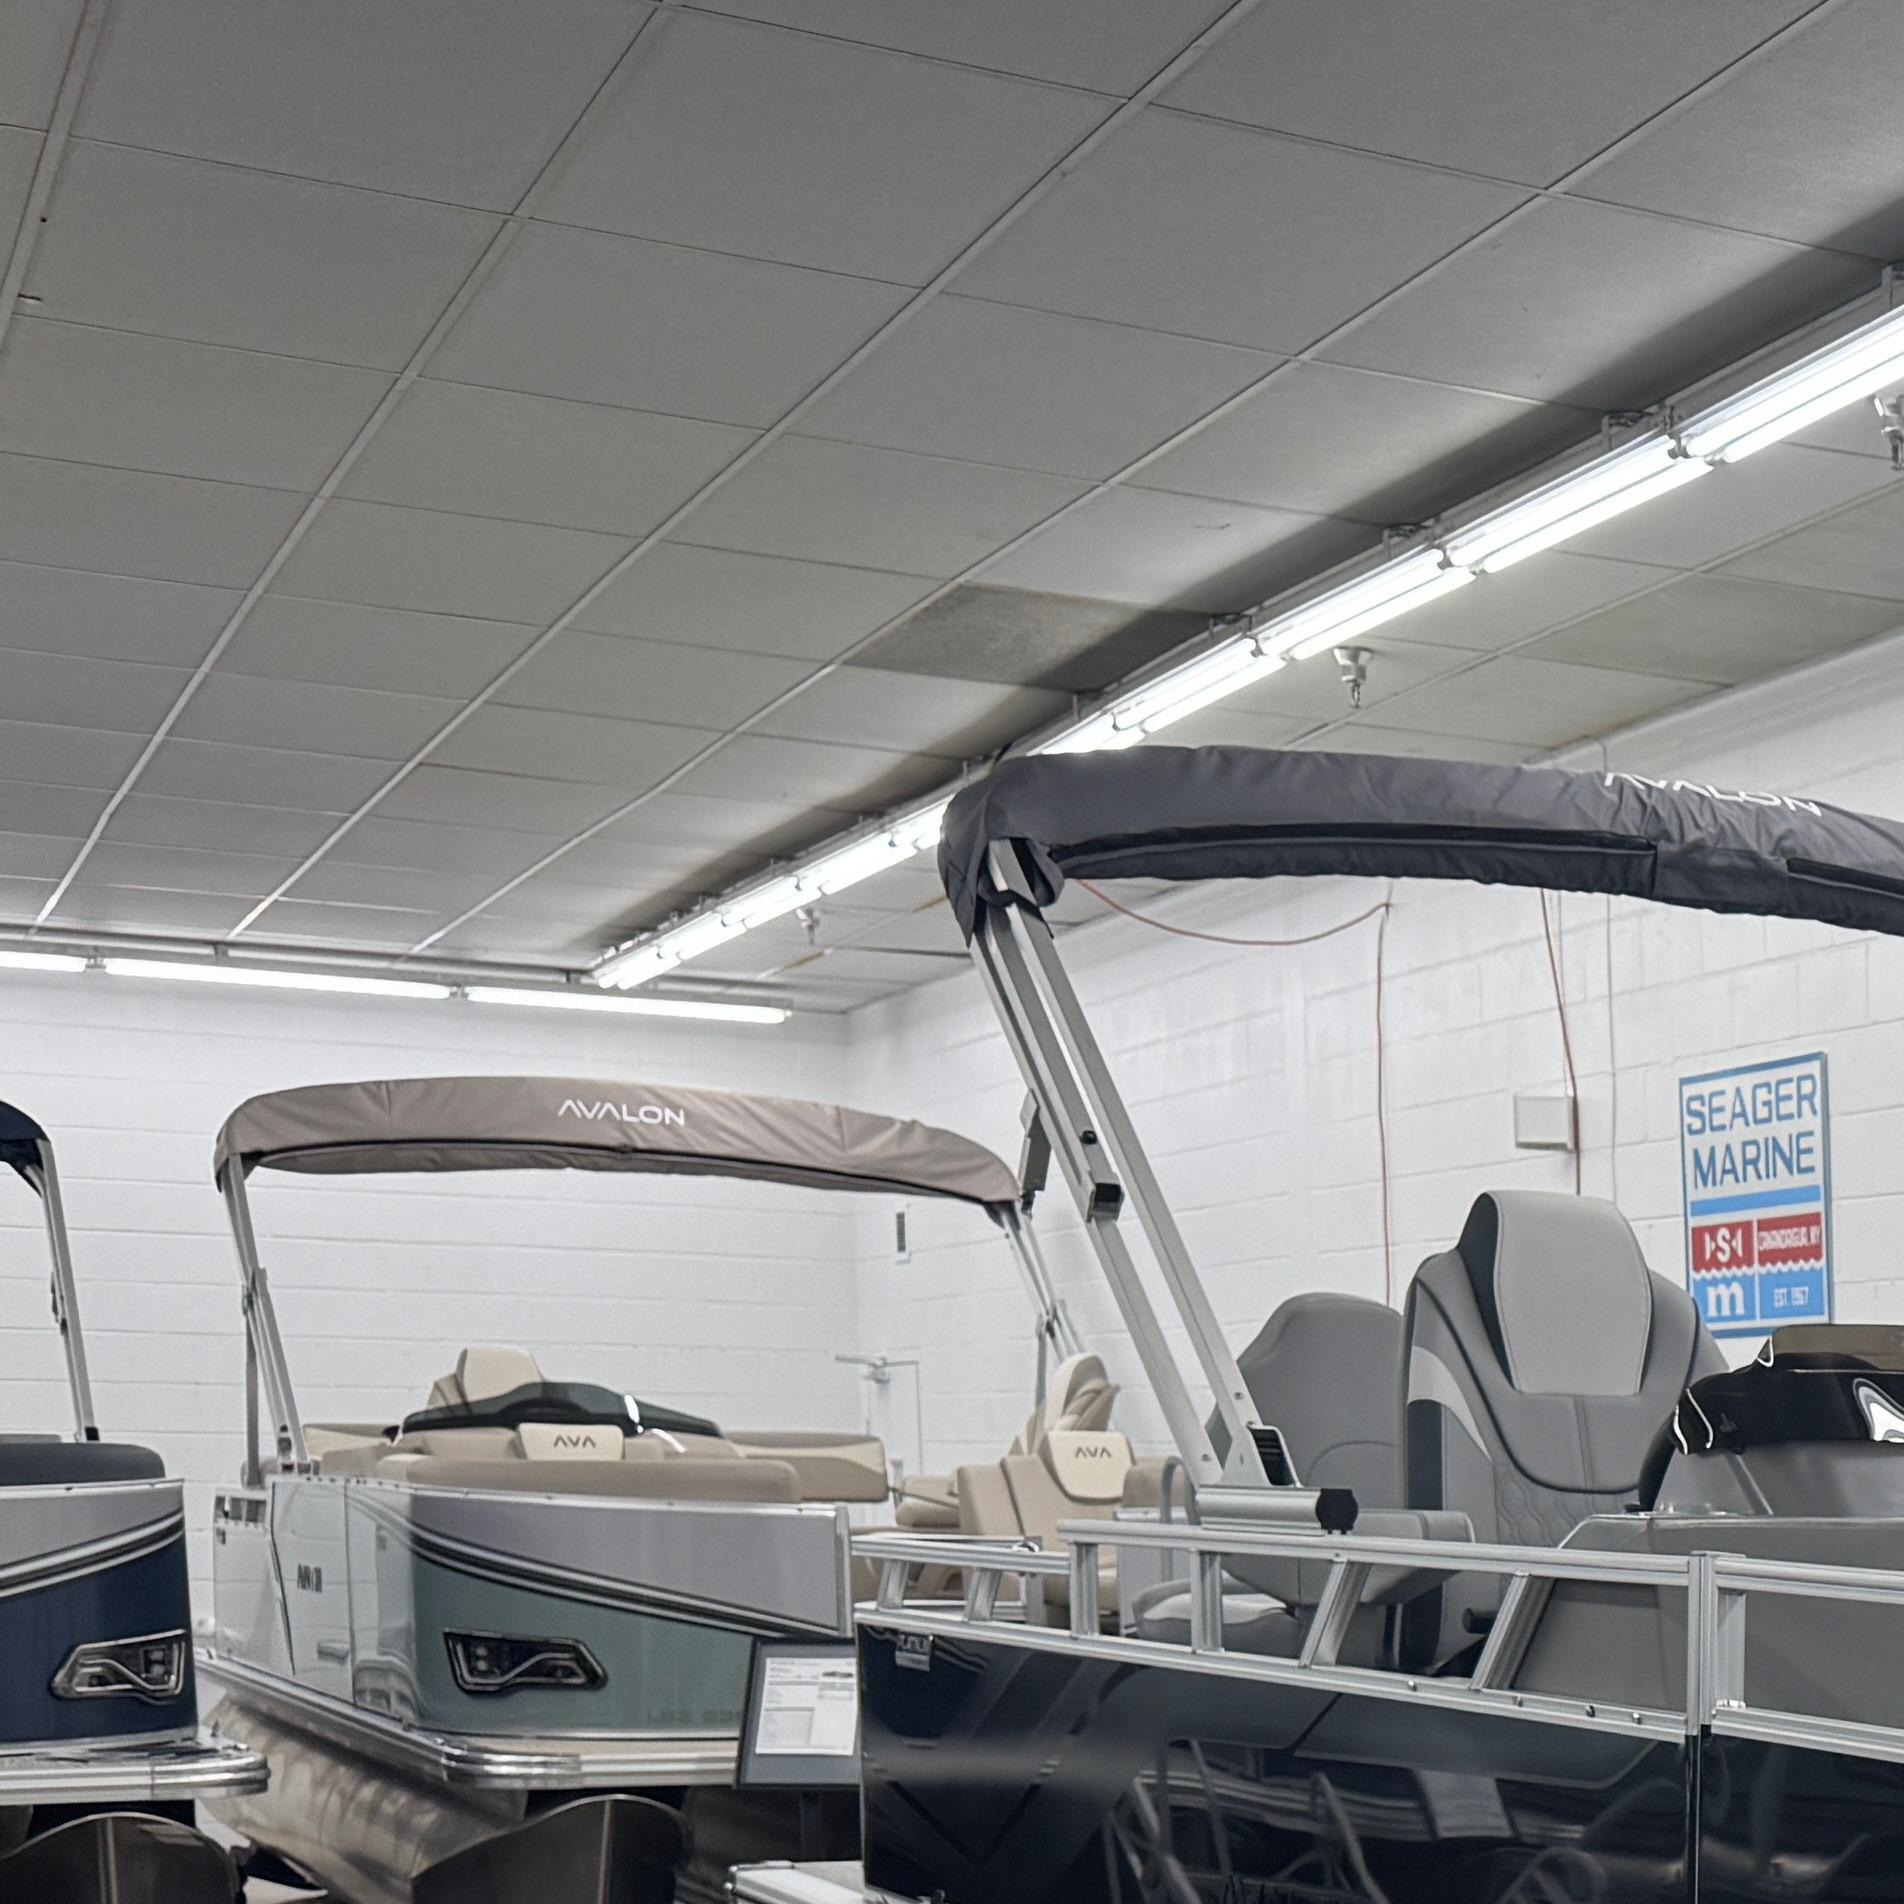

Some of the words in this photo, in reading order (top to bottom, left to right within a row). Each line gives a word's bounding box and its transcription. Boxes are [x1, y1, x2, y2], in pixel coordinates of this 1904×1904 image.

[1603, 772, 1822, 817] AVALON
[557, 1098, 686, 1127] AVALON
[1685, 1073, 1818, 1136] SEAGER
[1692, 1130, 1816, 1189] MARINE
[553, 1434, 597, 1449] AVA
[1074, 1446, 1112, 1459] AVA
